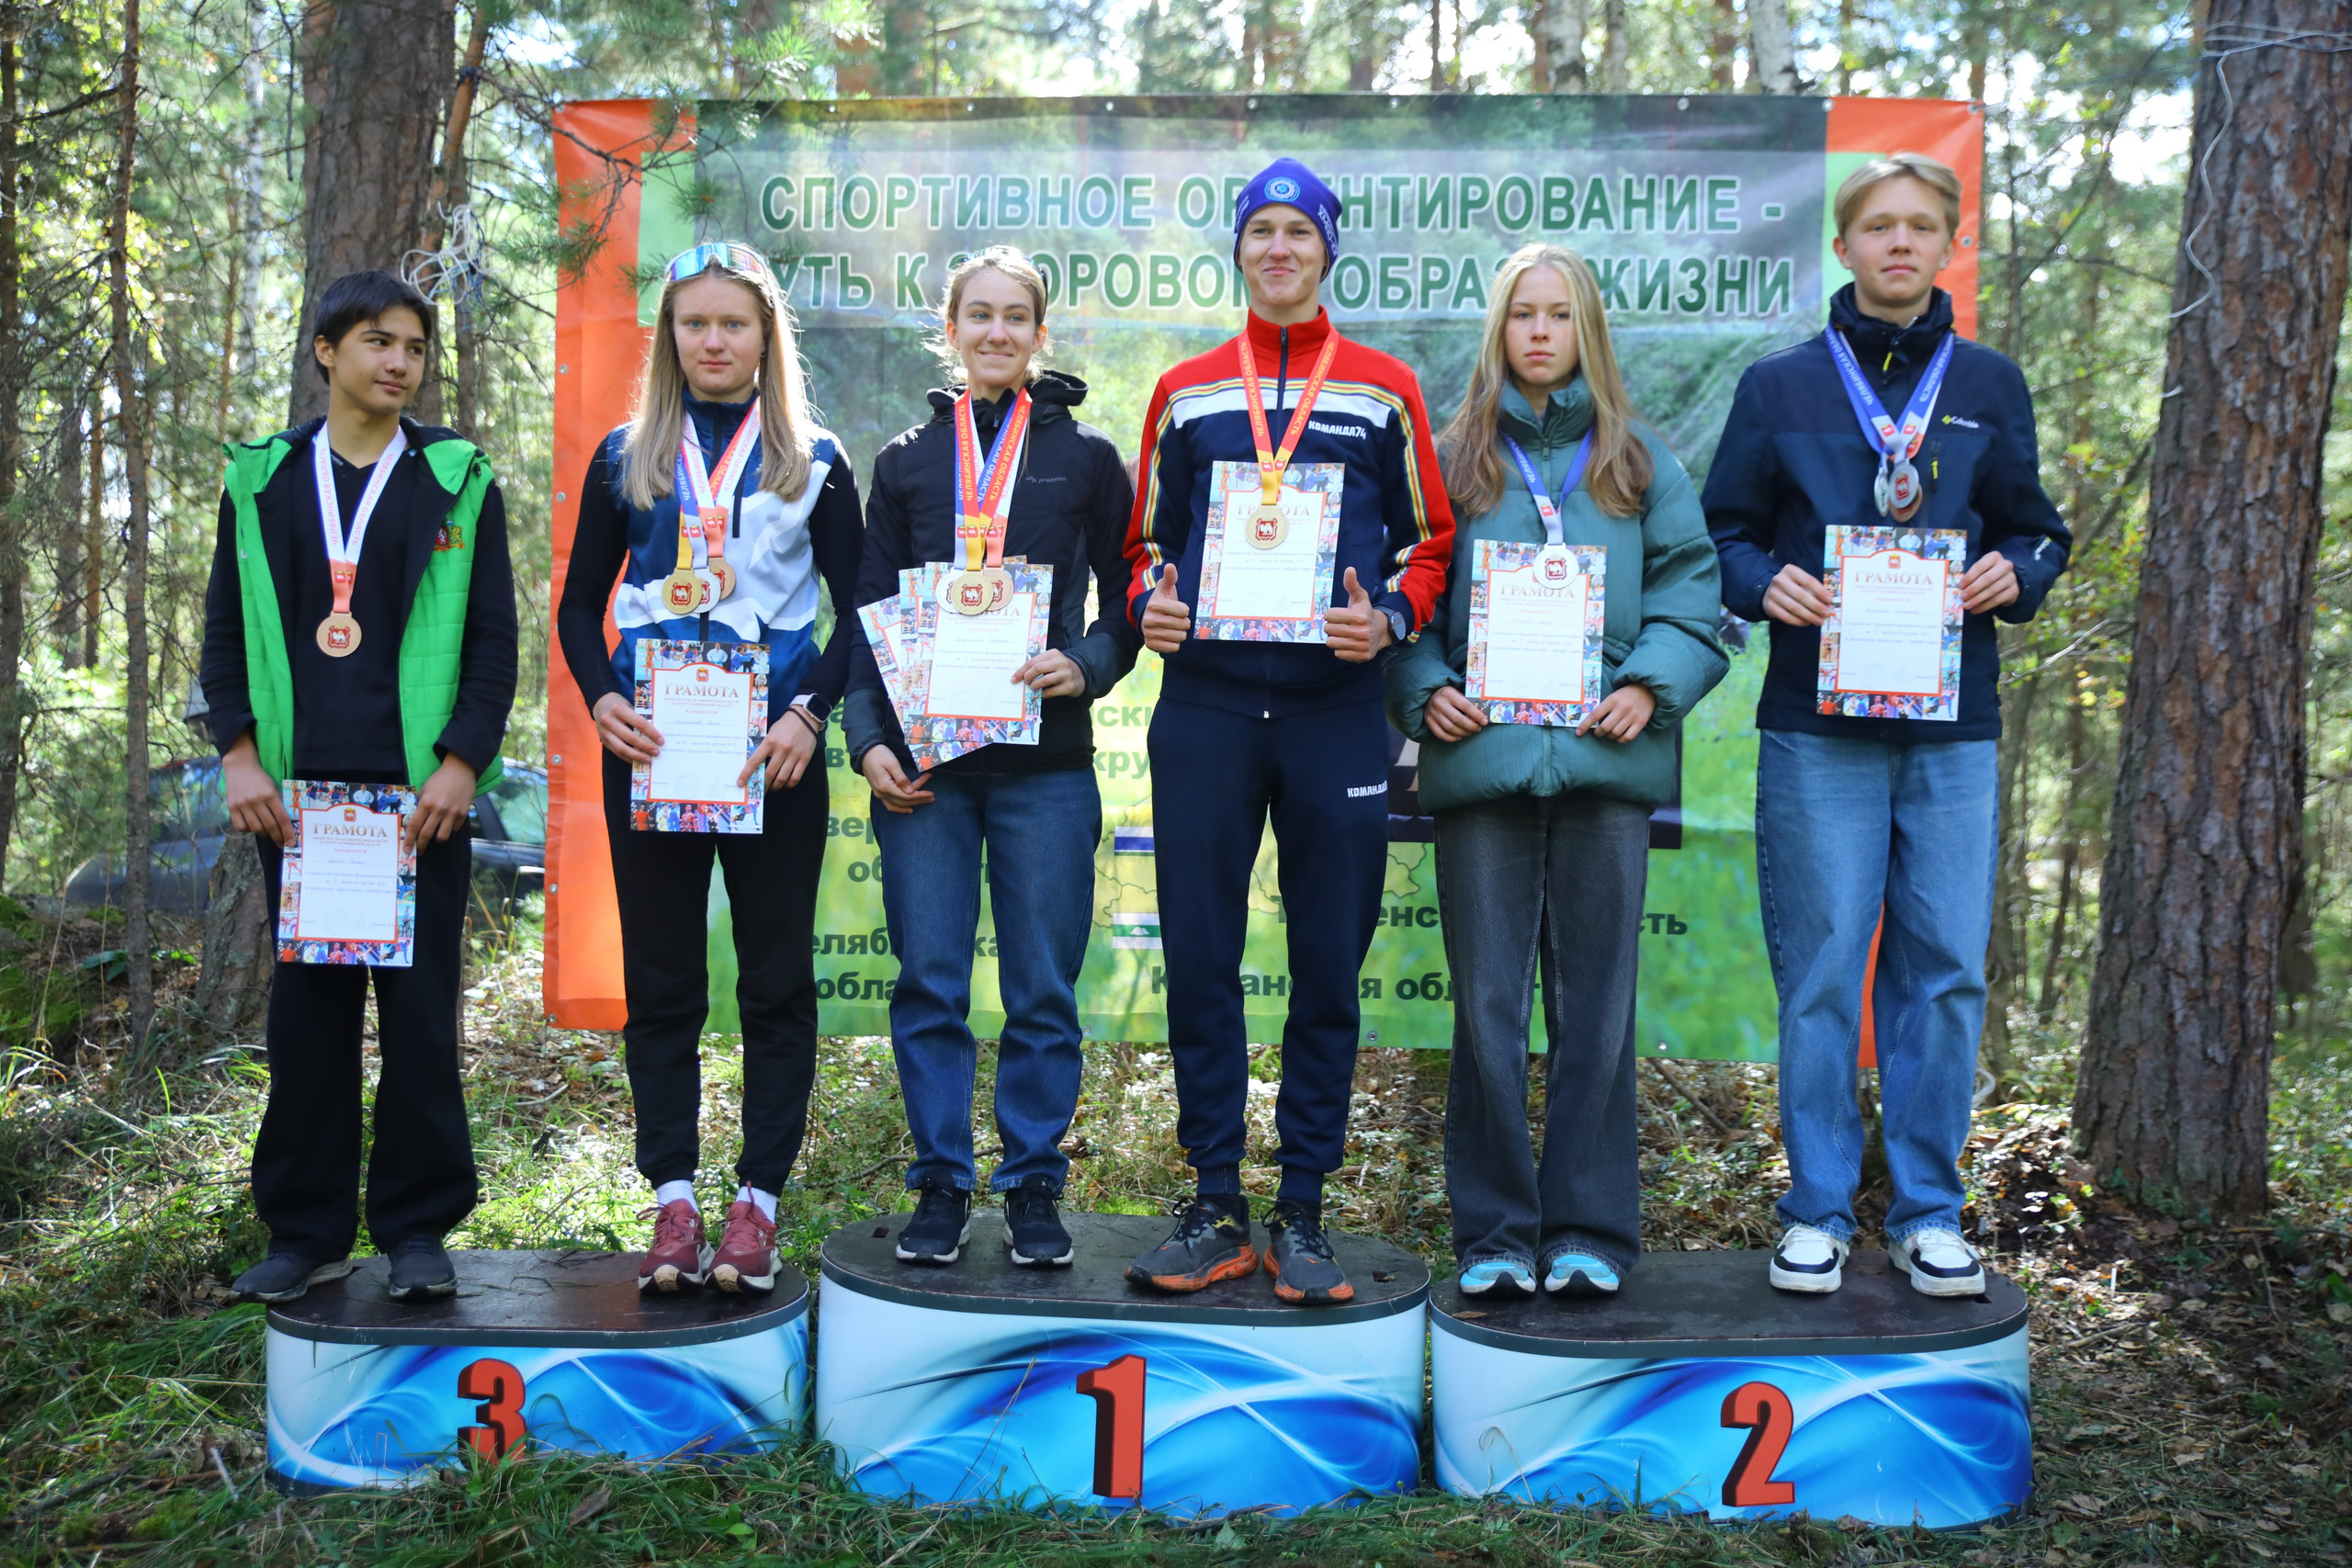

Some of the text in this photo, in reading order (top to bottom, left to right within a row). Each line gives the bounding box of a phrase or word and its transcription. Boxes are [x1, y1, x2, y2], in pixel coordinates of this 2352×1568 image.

[762, 175, 1155, 231] СПОРТИВНОЕ
[1178, 174, 1739, 233] ОРНТИРОВАНИЕ
[768, 253, 874, 310] УТЬ
[895, 252, 927, 310] К
[1332, 255, 1508, 312] ОБРА
[1585, 256, 1792, 315] ЖИЗНИ
[1002, 404, 1027, 462] ЧЕЛЯБИНСКАЯ
[1247, 377, 1265, 437] ЧЕЛЯБИНСКАЯ
[1290, 397, 1311, 435] ОБЛАСТЬ
[1307, 420, 1367, 440] КОМАНДА74
[958, 402, 974, 502] ЧЕЛЯБИНСКАЯ ОБЛАСТЬ
[989, 462, 1008, 501] ОБЛАСТЬ
[1237, 504, 1311, 516] ГРОТА
[324, 483, 339, 546] ЧЕЛЯБИНСКАЯ
[1500, 584, 1576, 598] ГРАМОТА
[1854, 570, 1933, 585] ГРАМОТА
[664, 683, 740, 698] ГРАМОТА
[313, 823, 389, 838] ГРАМОТА
[458, 1357, 527, 1471] 3
[1075, 1353, 1147, 1498] 1
[1720, 1380, 1795, 1507] 2
